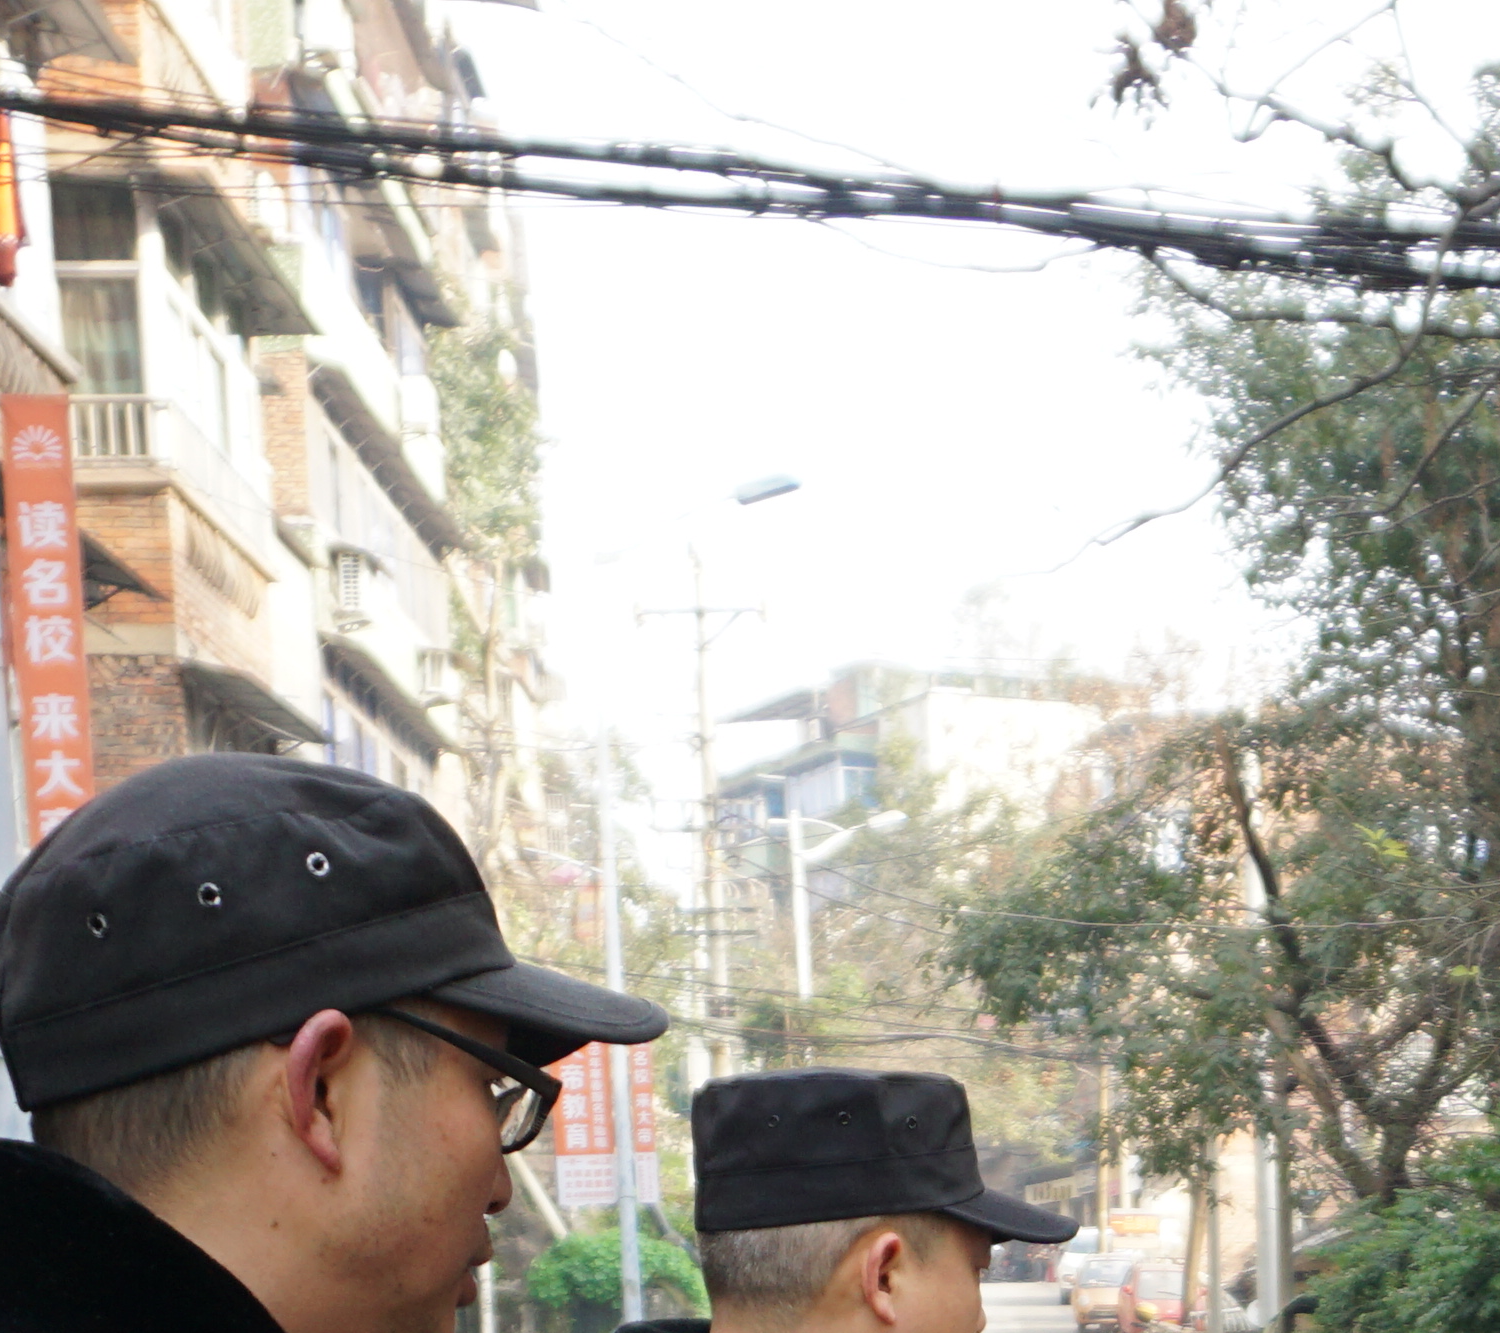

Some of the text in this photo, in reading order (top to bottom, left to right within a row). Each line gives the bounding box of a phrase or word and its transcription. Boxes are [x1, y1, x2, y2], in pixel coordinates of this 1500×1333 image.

[17, 501, 76, 663] 读名校
[560, 1050, 589, 1149] 帝教育
